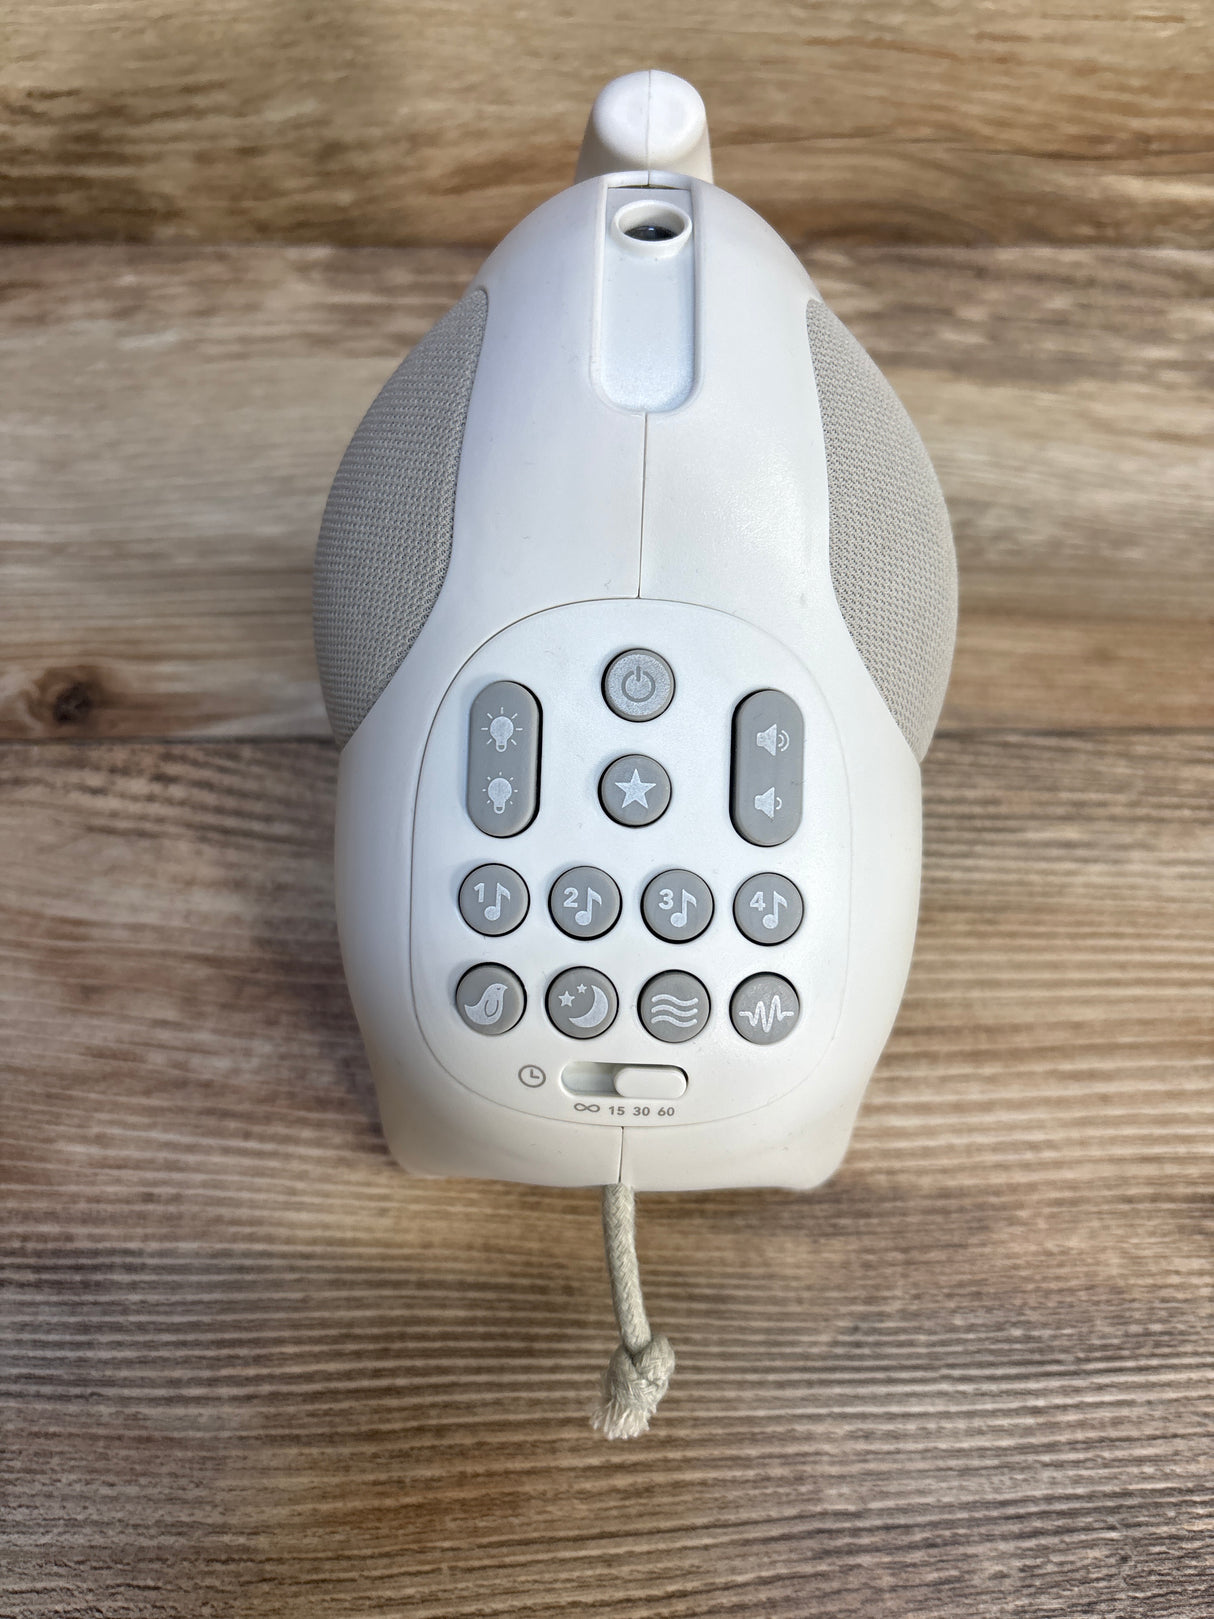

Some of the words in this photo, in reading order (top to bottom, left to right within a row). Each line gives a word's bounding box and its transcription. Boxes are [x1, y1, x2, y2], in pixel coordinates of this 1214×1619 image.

[473, 882, 485, 903] 1
[563, 887, 579, 908] 2
[658, 888, 674, 910] 3
[750, 891, 766, 912] 4
[608, 1105, 625, 1116] 15
[633, 1106, 651, 1117] 30
[657, 1106, 675, 1117] 60
